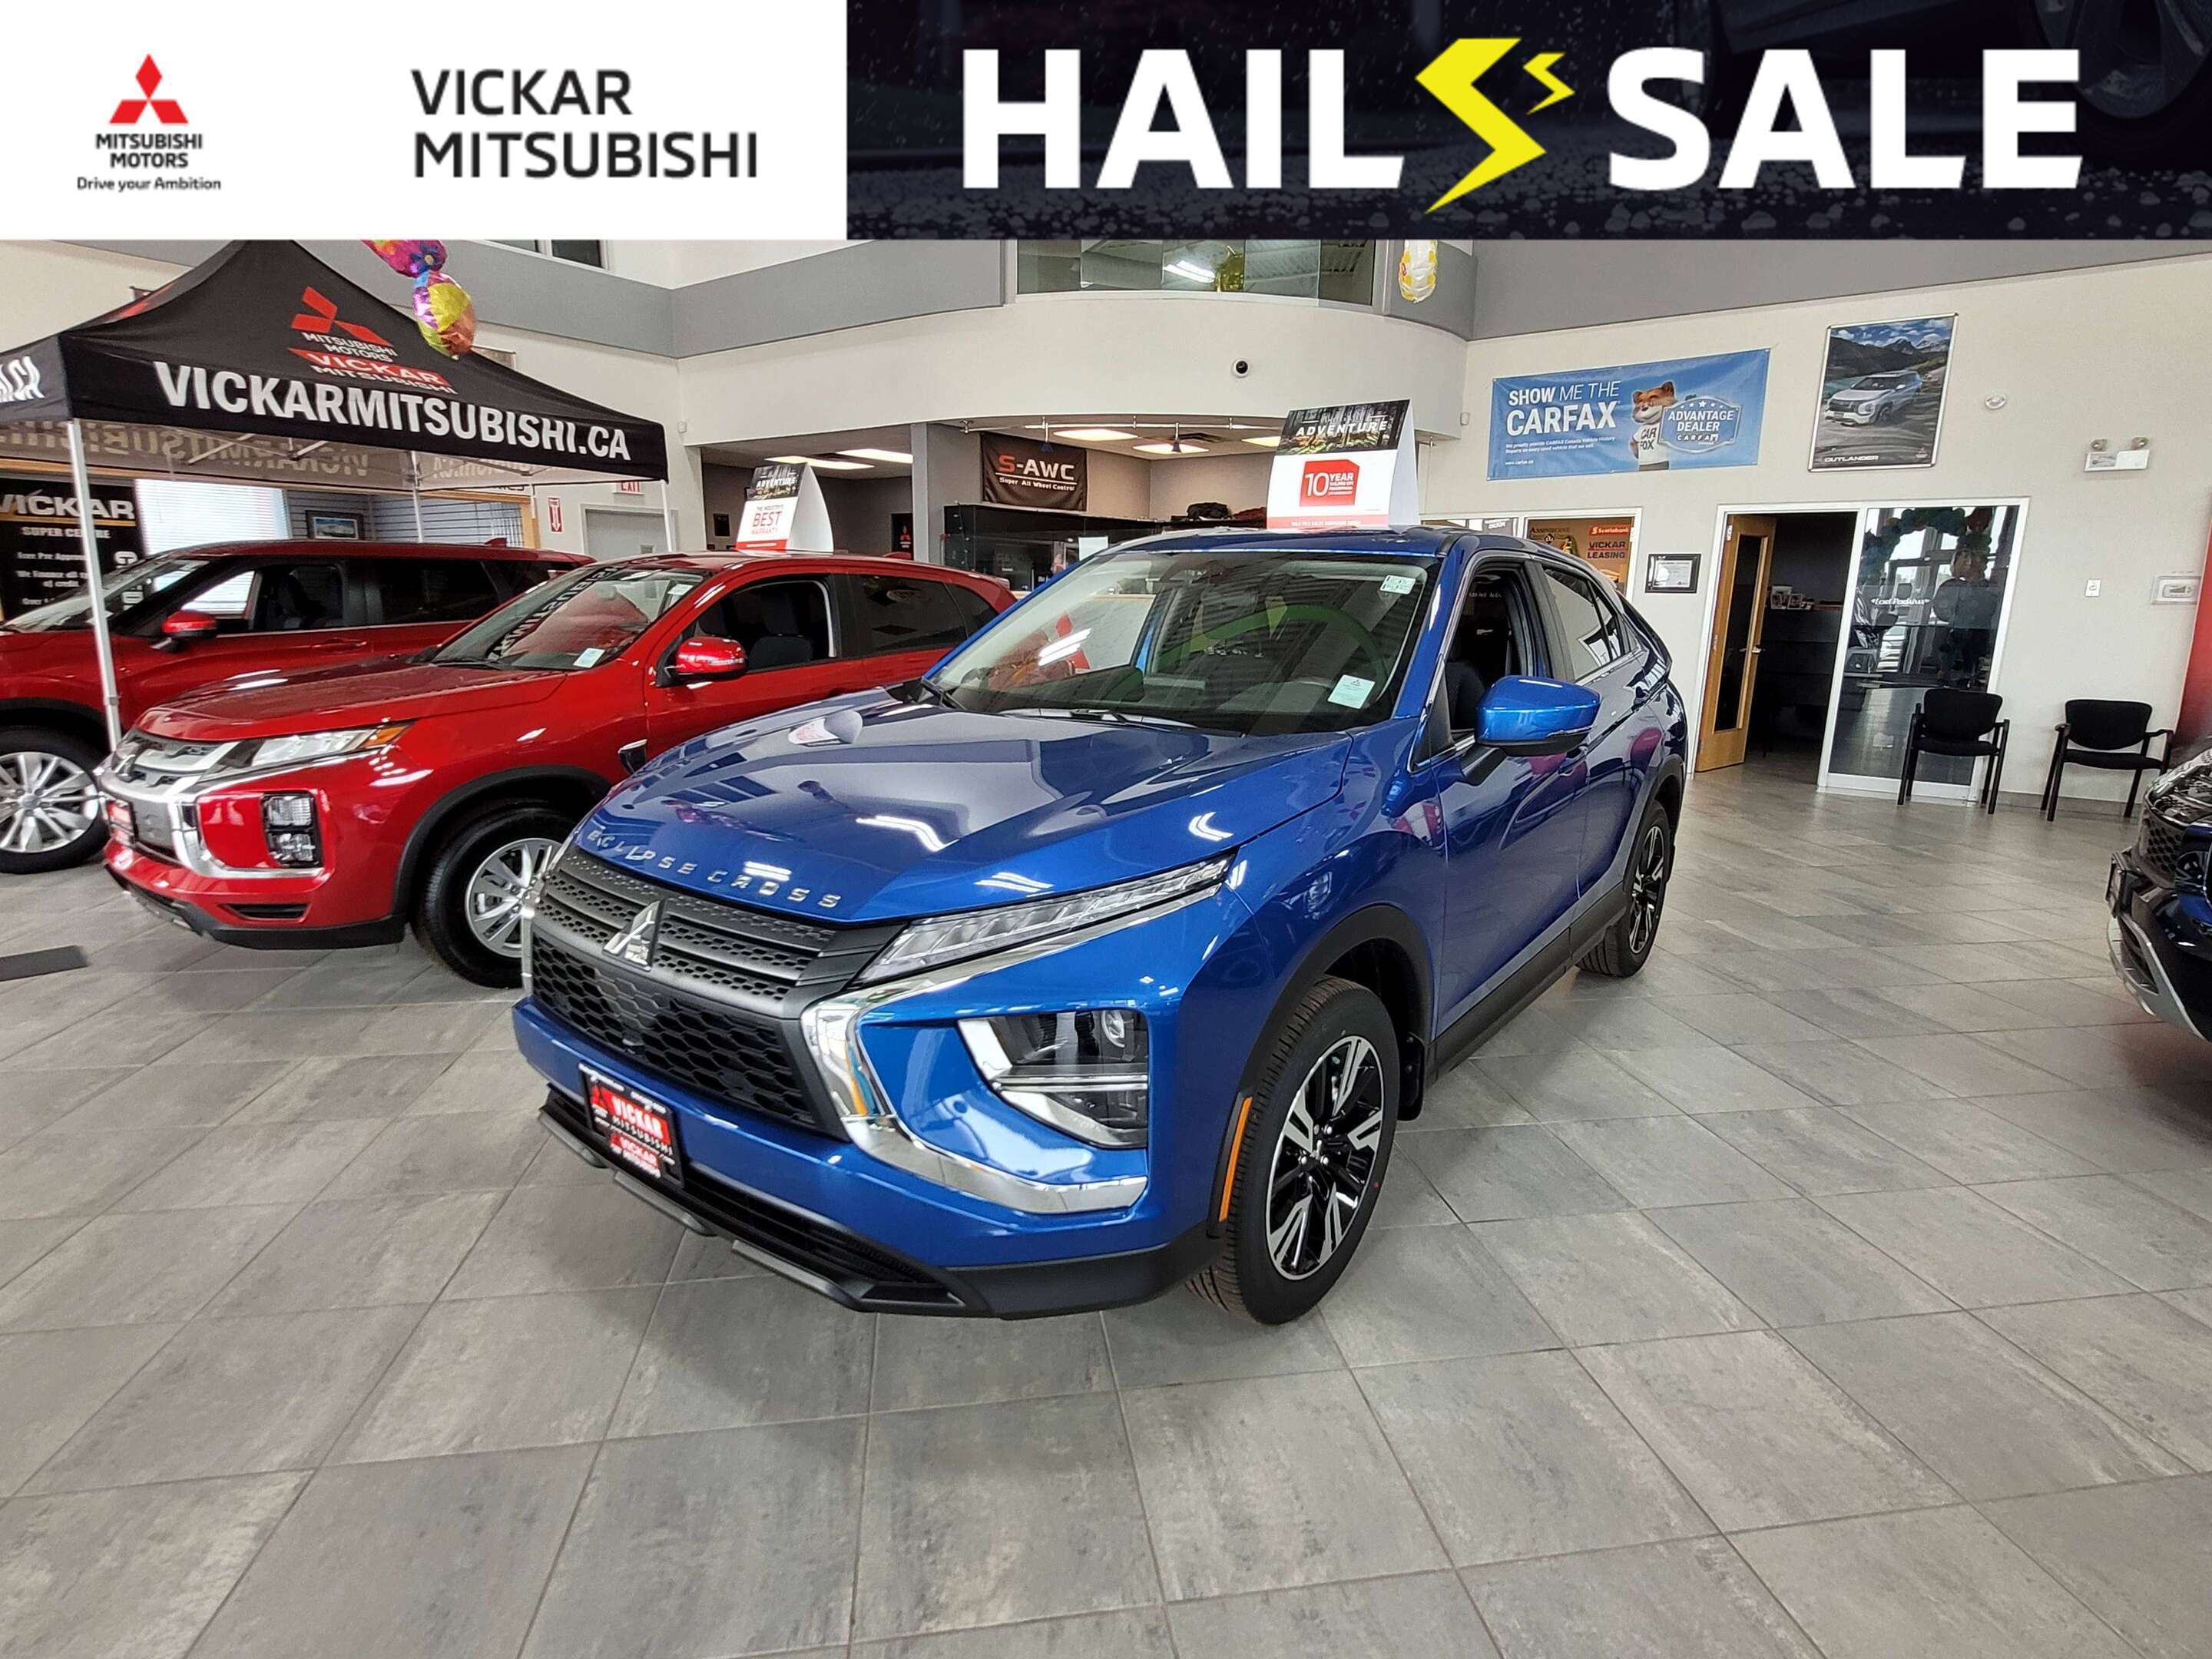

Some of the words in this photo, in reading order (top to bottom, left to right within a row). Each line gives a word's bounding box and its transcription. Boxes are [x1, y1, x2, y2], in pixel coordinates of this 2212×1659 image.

[301, 332, 398, 357] MITSUBISHI
[323, 343, 393, 363] MOTORS
[307, 353, 443, 385] VICKAR
[310, 365, 458, 394] MITSUBISHI
[1508, 387, 1556, 406] SHOW
[1559, 384, 1584, 401] ME
[1588, 381, 1622, 398] THE
[154, 360, 631, 461] VICKARMITSUBISHI.CA
[1507, 401, 1617, 436] CARFAX
[1668, 410, 1734, 421] ADVANTAGE
[1296, 421, 1388, 436] ADVENTURE
[1641, 427, 1657, 439] CAR
[1677, 422, 1720, 432] DEALER
[1640, 440, 1654, 450] FOX
[998, 455, 1075, 480] S-AWC
[999, 476, 1018, 485] Super
[1305, 472, 1330, 497] 10
[1330, 472, 1354, 482] YEAR
[752, 511, 782, 527] BEST
[22, 526, 63, 537] SUPER
[1598, 526, 1629, 535] Scotiabank
[1588, 541, 1626, 549] VICKAR
[588, 827, 697, 875] ECLIPSE
[707, 870, 842, 908] CROSS
[611, 1094, 664, 1140] VICKAR
